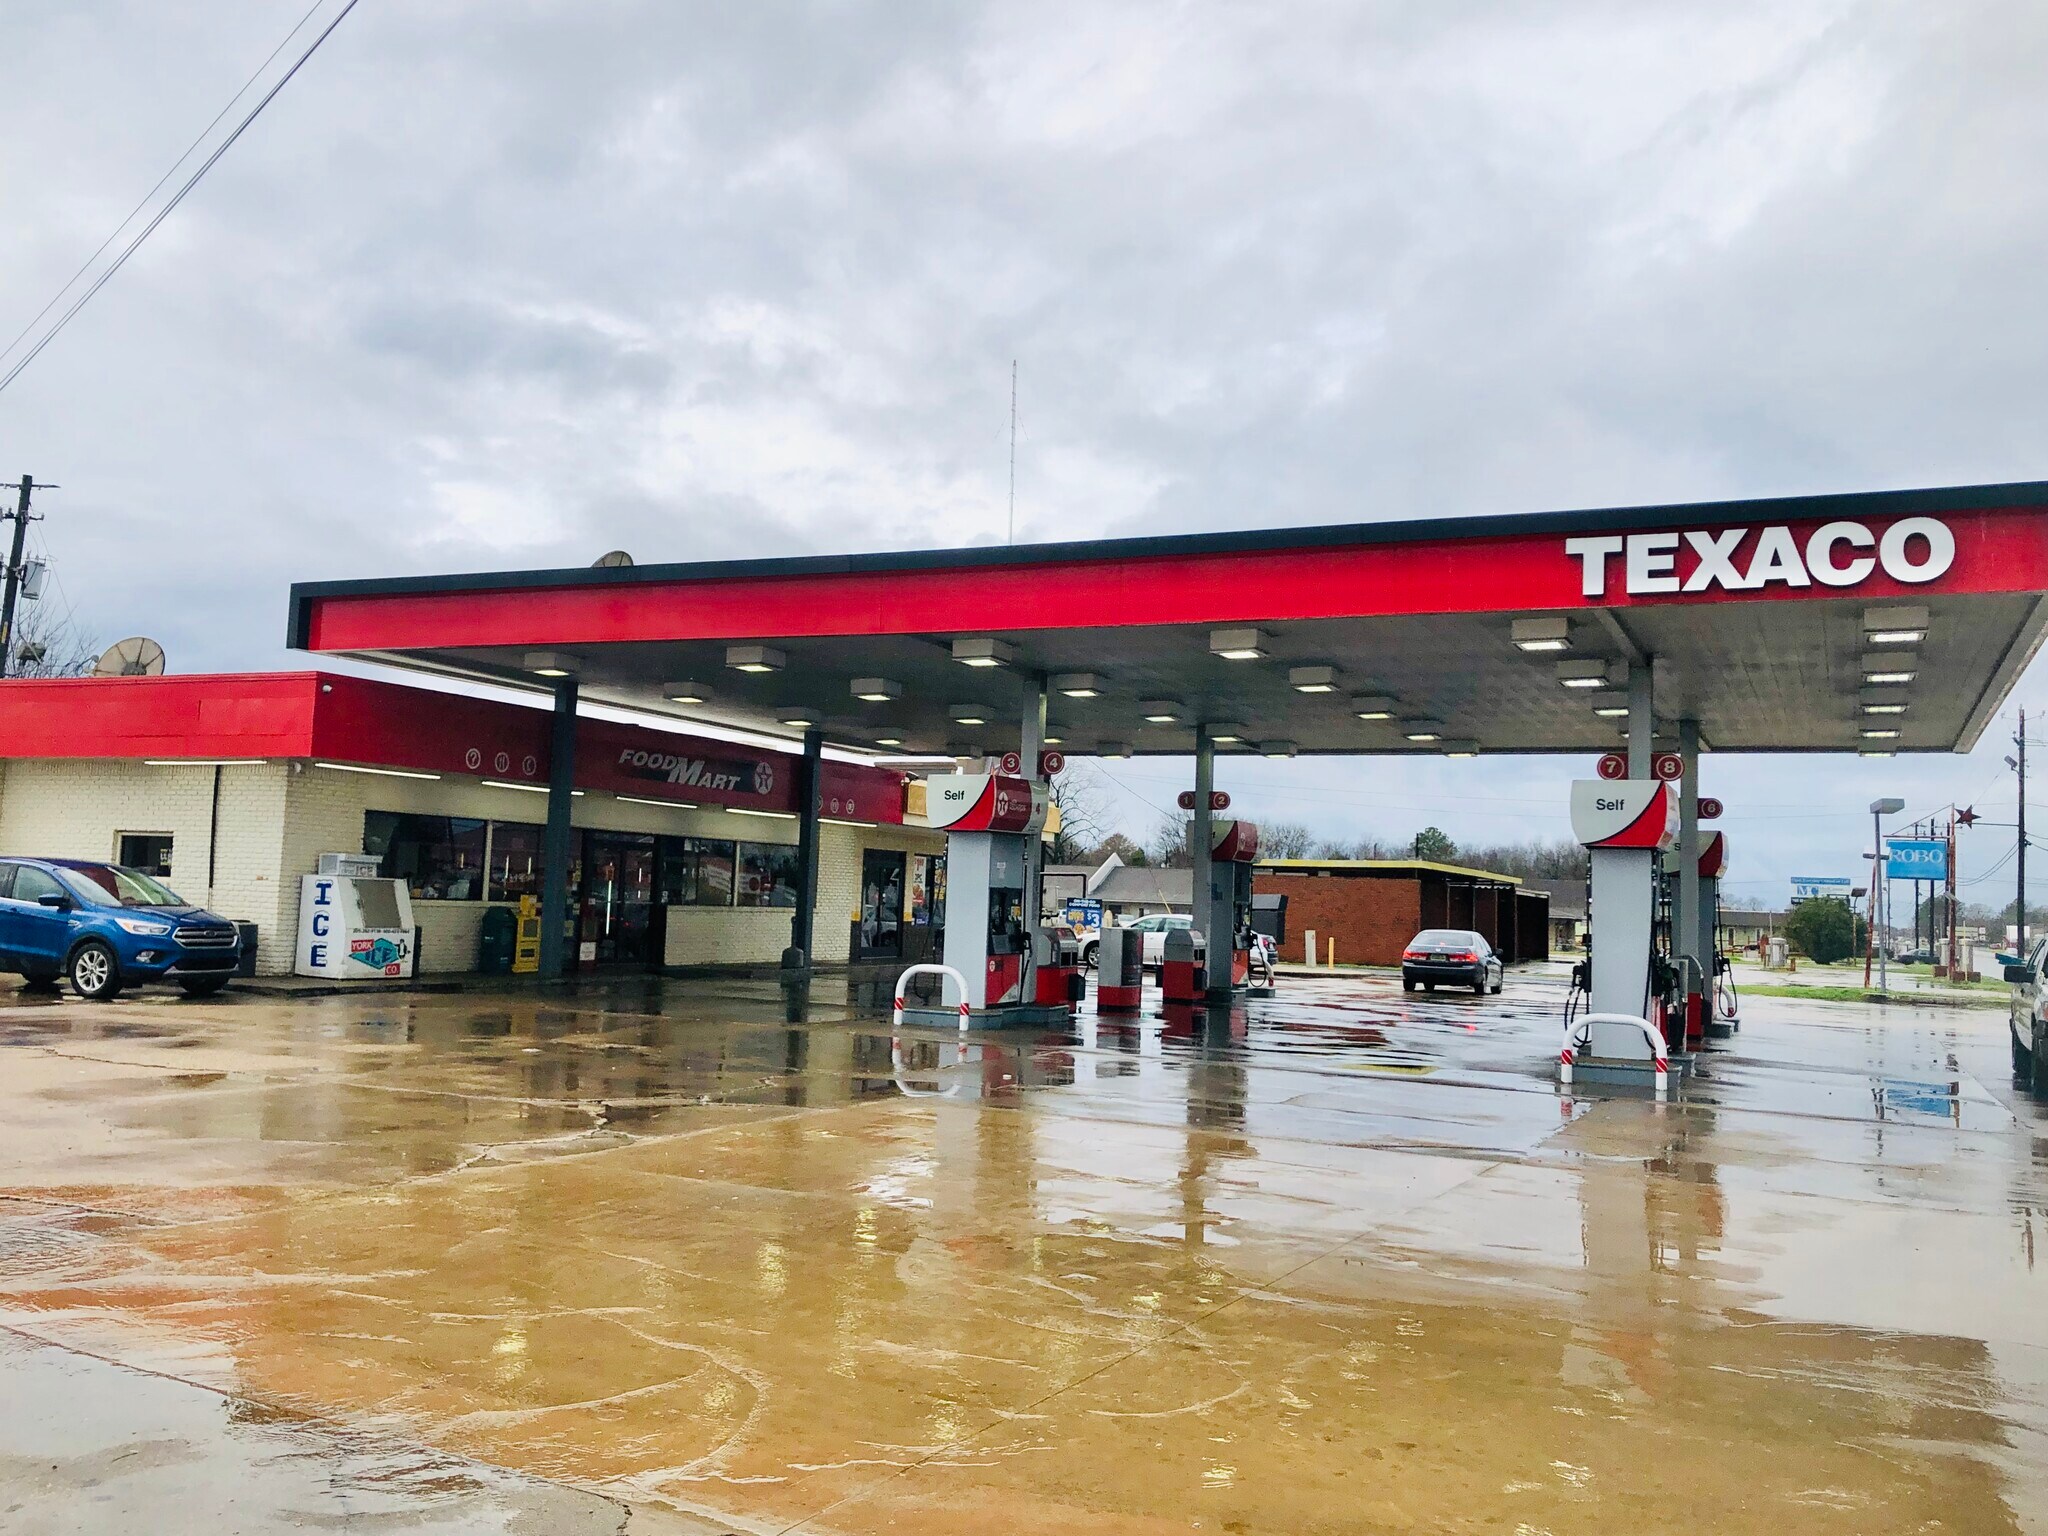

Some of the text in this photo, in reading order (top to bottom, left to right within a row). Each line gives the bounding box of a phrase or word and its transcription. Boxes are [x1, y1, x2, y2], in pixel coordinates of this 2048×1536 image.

[1565, 516, 1955, 595] TEXACO
[1007, 757, 1016, 768] 3
[1049, 757, 1058, 768] 4
[1605, 761, 1617, 773] 7
[1664, 761, 1676, 773] 8
[944, 789, 965, 801] Self
[1596, 797, 1625, 811] Self
[1889, 848, 1943, 863] ROBO
[310, 879, 333, 968] ICE
[351, 941, 373, 950] YORK
[365, 946, 394, 966] ICE
[385, 965, 399, 975] CO.
